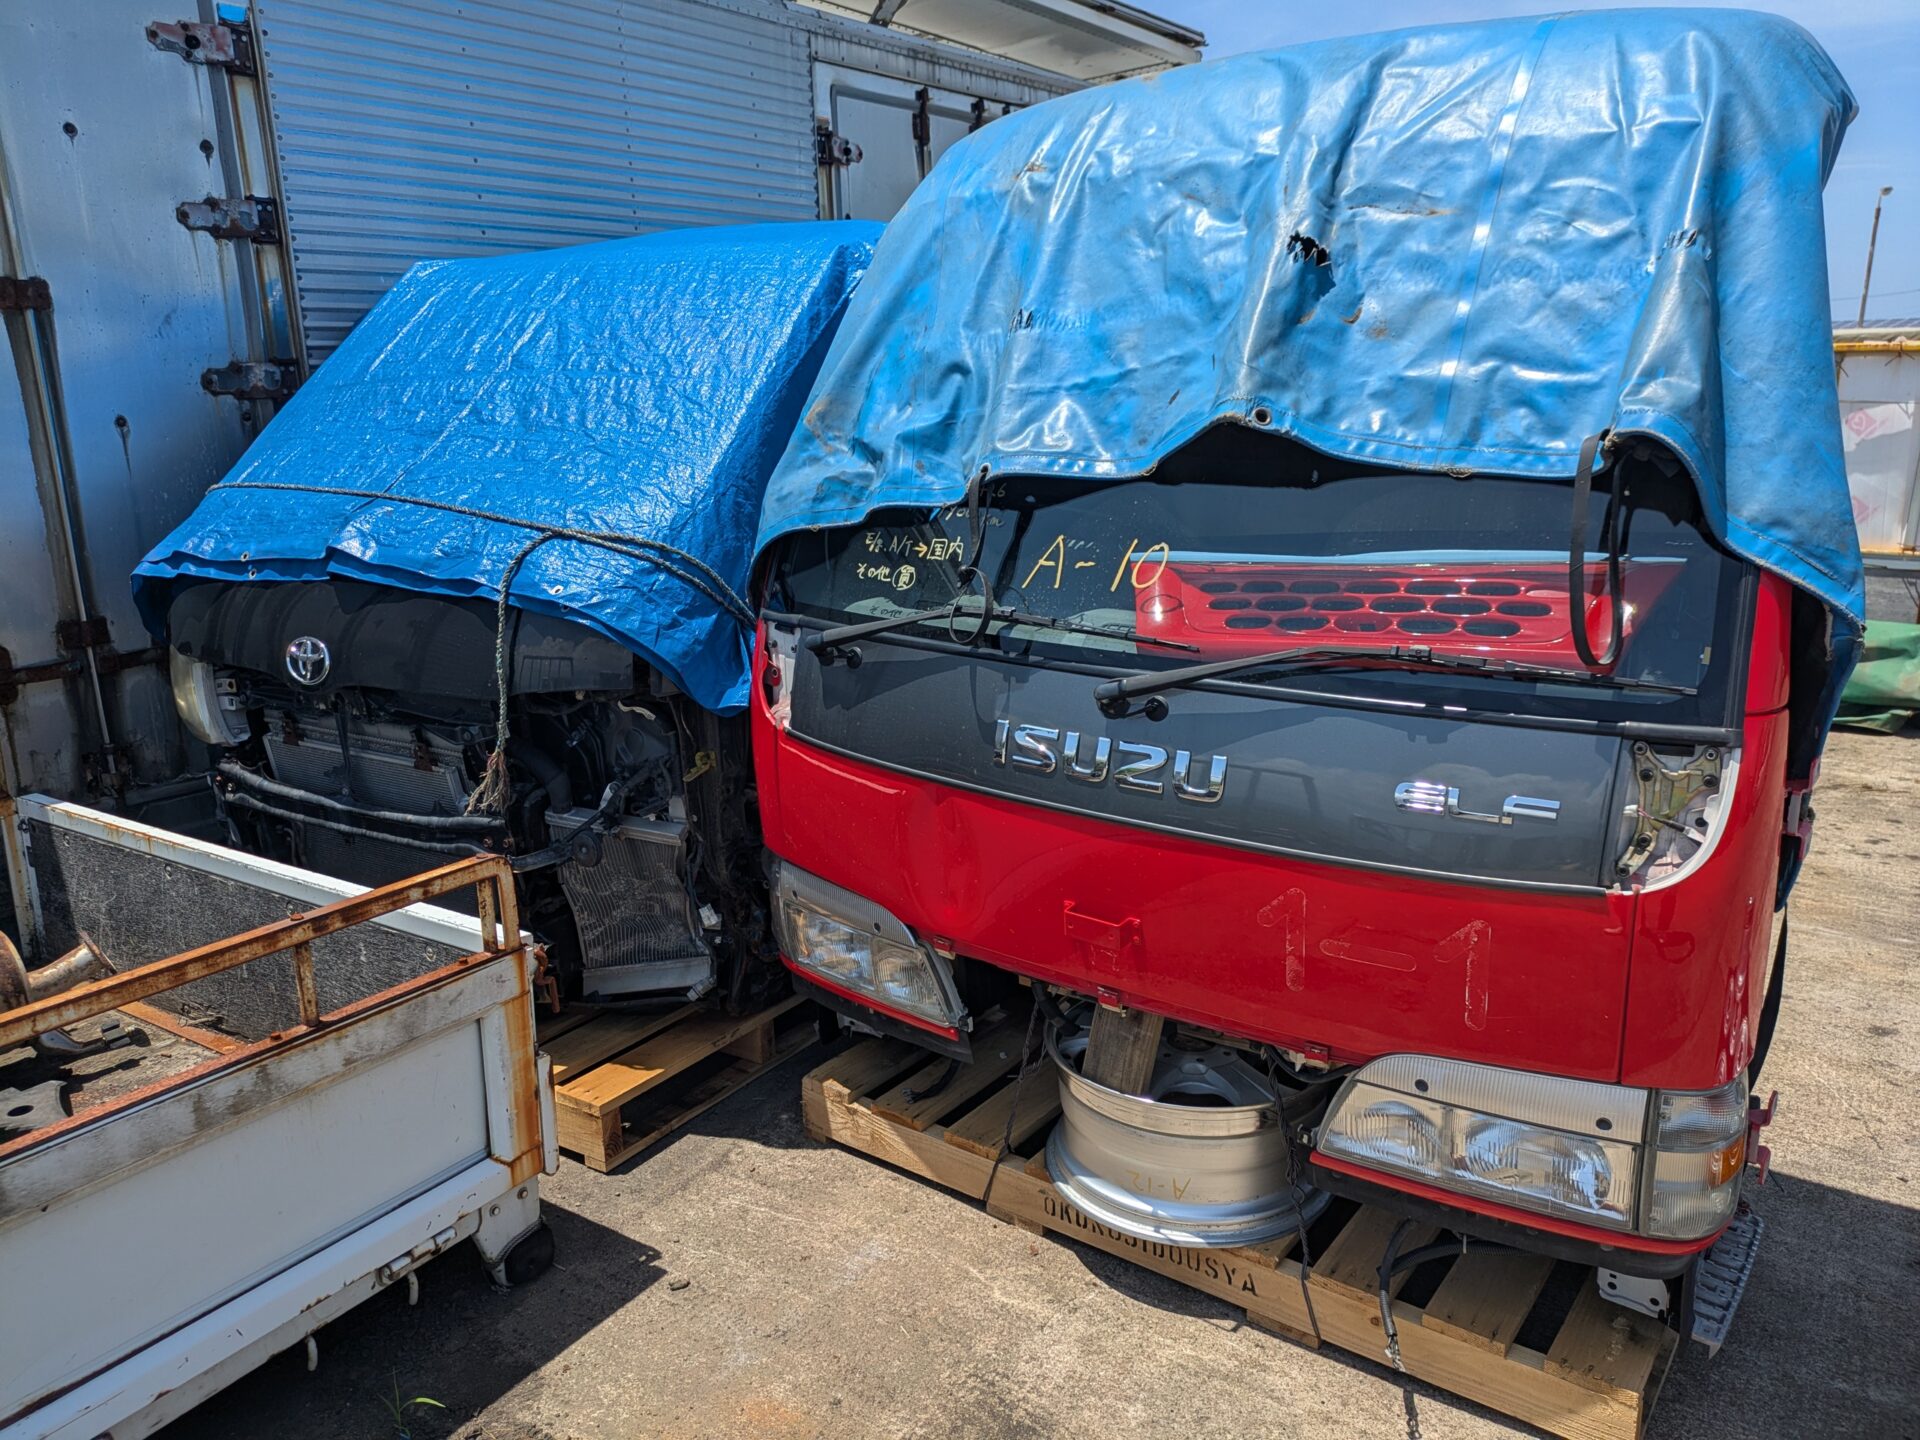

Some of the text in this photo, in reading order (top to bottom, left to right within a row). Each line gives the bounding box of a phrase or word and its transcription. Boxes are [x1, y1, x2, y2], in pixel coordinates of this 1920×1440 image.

[1021, 534, 1169, 592] A-10
[994, 719, 1227, 803] ISUZU
[1394, 782, 1561, 825] ELF
